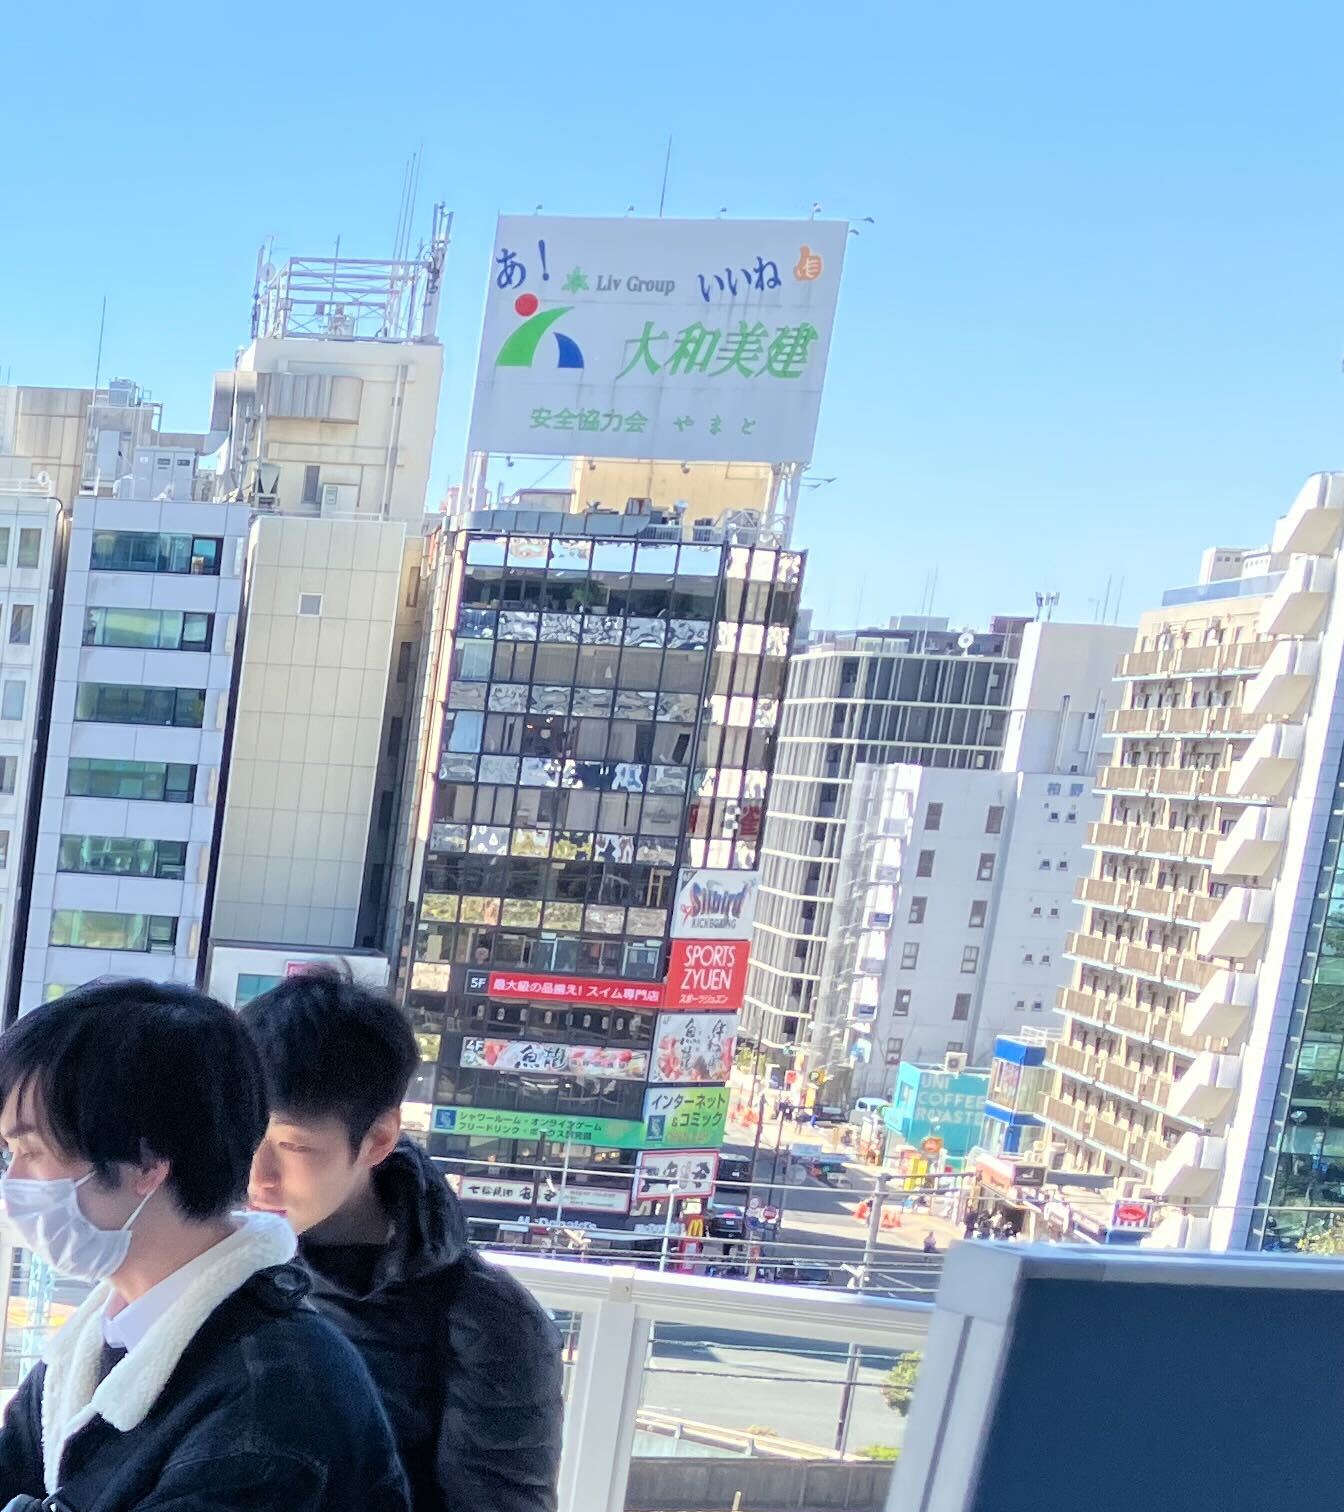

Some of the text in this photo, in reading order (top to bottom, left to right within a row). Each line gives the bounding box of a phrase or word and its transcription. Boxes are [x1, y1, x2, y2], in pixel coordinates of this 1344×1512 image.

[627, 275, 676, 297] Group
[698, 255, 782, 302] いいね
[616, 320, 819, 379] 大和美建
[529, 408, 649, 433] 安全協力会
[684, 945, 737, 967] SPORTS
[470, 977, 487, 989] 5F
[680, 968, 734, 990] ZYUEN
[652, 1093, 726, 1110] インターネット
[917, 1091, 986, 1109] COFFEE
